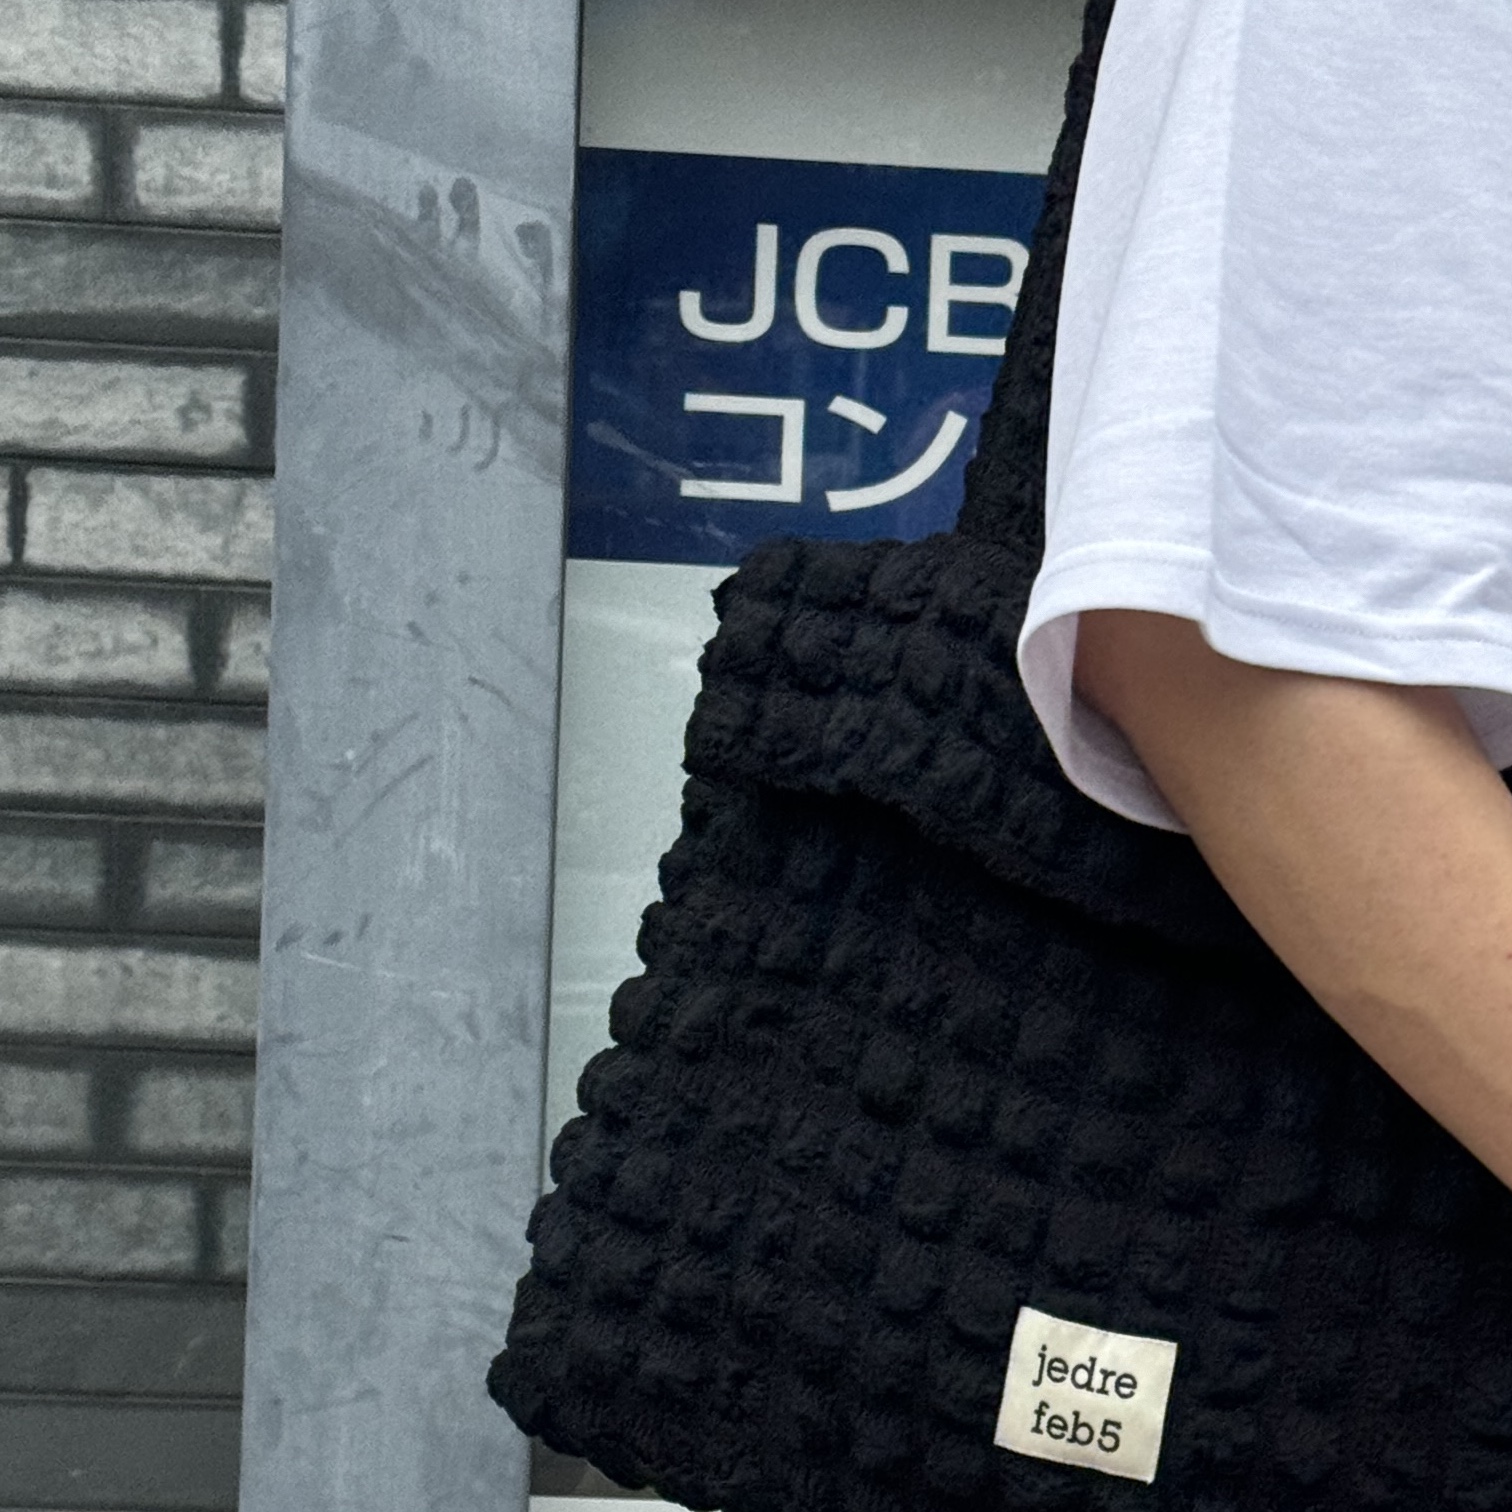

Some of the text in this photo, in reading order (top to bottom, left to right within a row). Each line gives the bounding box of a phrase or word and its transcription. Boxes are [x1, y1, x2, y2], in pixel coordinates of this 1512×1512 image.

[678, 223, 1030, 356] JCB
[679, 393, 968, 512] コン
[1032, 1344, 1138, 1399] jedre
[1030, 1400, 1123, 1453] feb5
